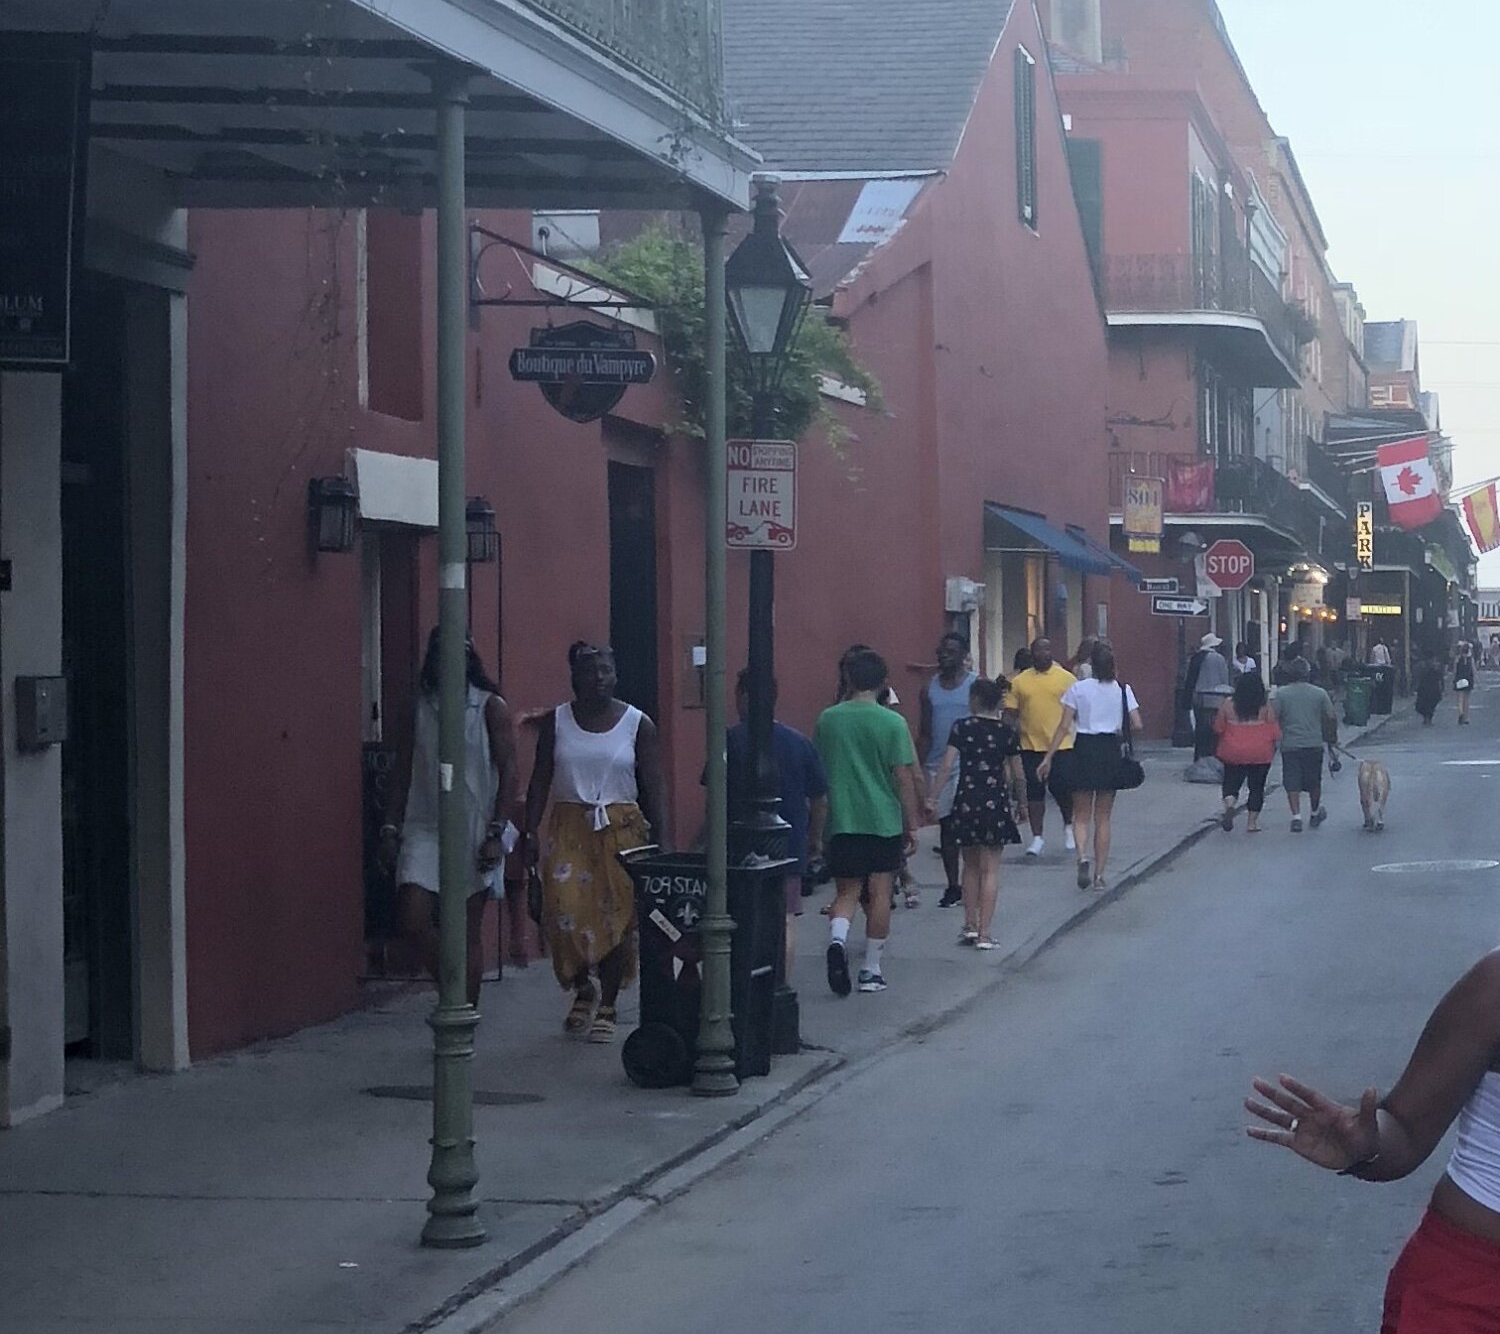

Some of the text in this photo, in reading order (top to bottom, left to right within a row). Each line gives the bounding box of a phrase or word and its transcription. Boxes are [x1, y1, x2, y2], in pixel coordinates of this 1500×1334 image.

[517, 352, 647, 381] Boutique du Vampyre
[728, 446, 750, 466] NO
[742, 477, 779, 494] FIRE
[739, 500, 782, 517] LANE
[1359, 504, 1371, 569] PARK
[1208, 555, 1250, 574] STOP
[1158, 601, 1193, 611] ONE WAY
[640, 875, 671, 896] 709
